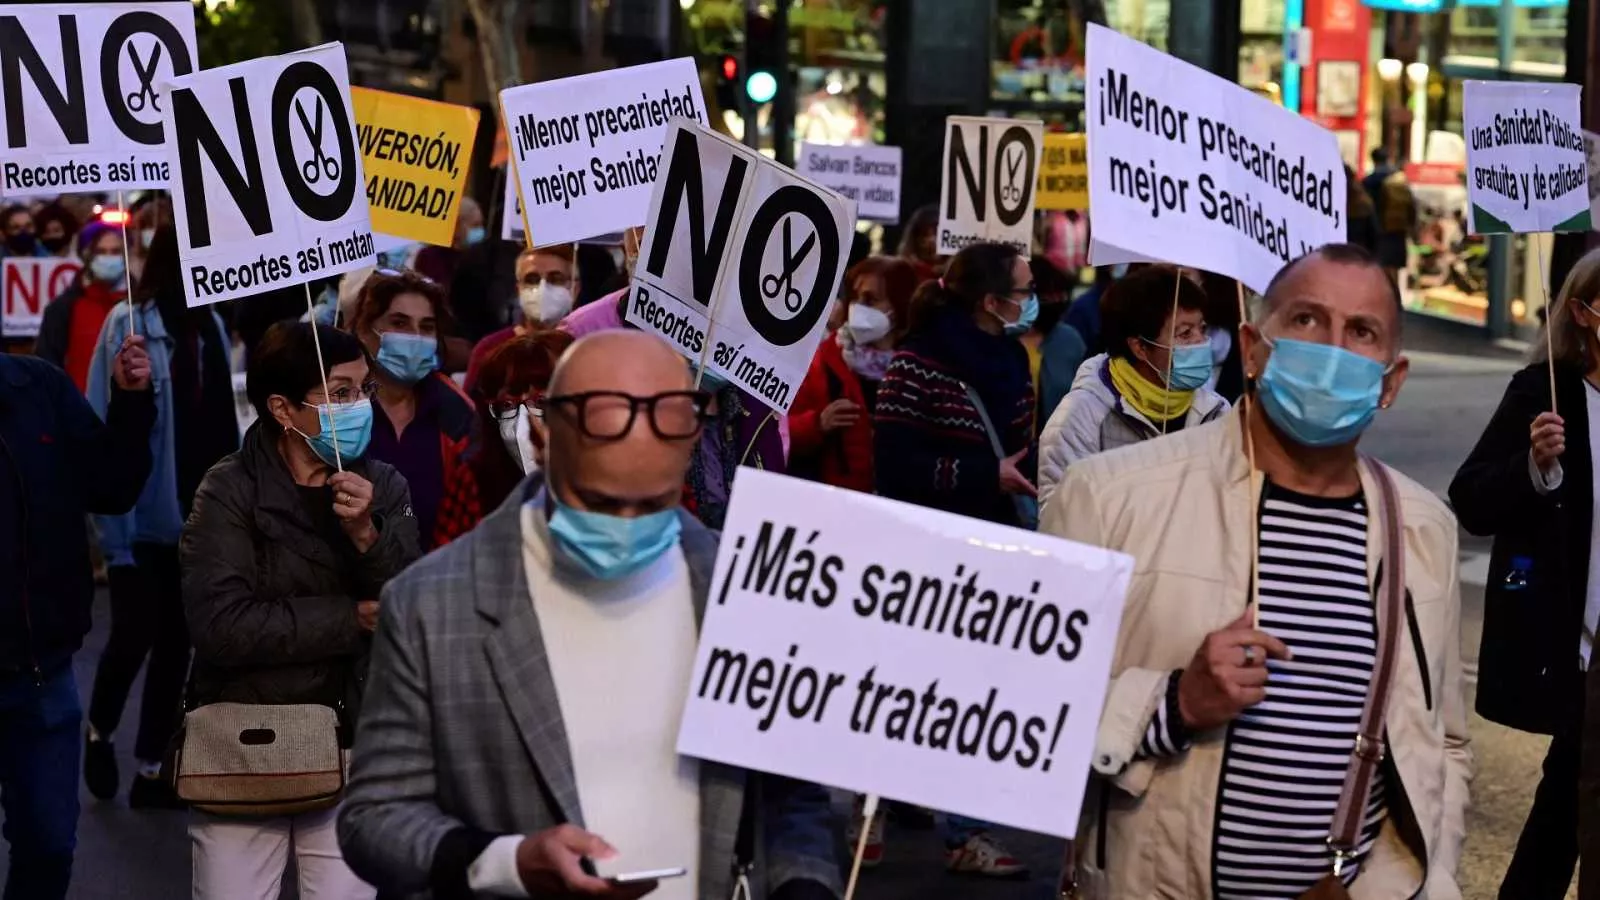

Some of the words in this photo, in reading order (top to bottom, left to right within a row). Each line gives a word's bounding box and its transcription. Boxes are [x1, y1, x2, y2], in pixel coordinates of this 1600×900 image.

[0, 11, 193, 148] NO
[515, 114, 580, 161] ¡Menor
[584, 85, 702, 147] precariedad,
[5, 161, 101, 189] Recortes
[108, 155, 136, 182] así
[171, 61, 357, 249] NO
[356, 124, 460, 179] NVERSIÓN,
[808, 153, 849, 174] Salvan
[853, 156, 897, 176] Bancos
[1100, 68, 1189, 143] ¡Menor
[1197, 116, 1339, 229] precariedad,
[1472, 126, 1493, 151] Una
[1494, 108, 1543, 146] Sanidad
[365, 174, 455, 220] ANIDAD!
[532, 164, 586, 209] mejor
[590, 144, 665, 193] Sanida
[946, 125, 1035, 226] NO
[1110, 156, 1189, 218] mejor
[1198, 173, 1291, 263] Sanidad
[1475, 163, 1519, 200] gratuita
[1520, 173, 1529, 210] y
[1533, 163, 1546, 200] de
[1549, 163, 1586, 200] calidad!
[191, 254, 292, 297] Recortes
[297, 238, 326, 273] así
[329, 230, 375, 266] matan
[646, 128, 840, 347] NO
[633, 286, 705, 353] Recortes
[713, 341, 744, 371] así
[734, 355, 790, 409] matan.
[718, 521, 844, 608] ¡Más
[852, 562, 1089, 663] sanitarios
[698, 644, 844, 732] mejor
[849, 665, 1070, 773] tratados!
